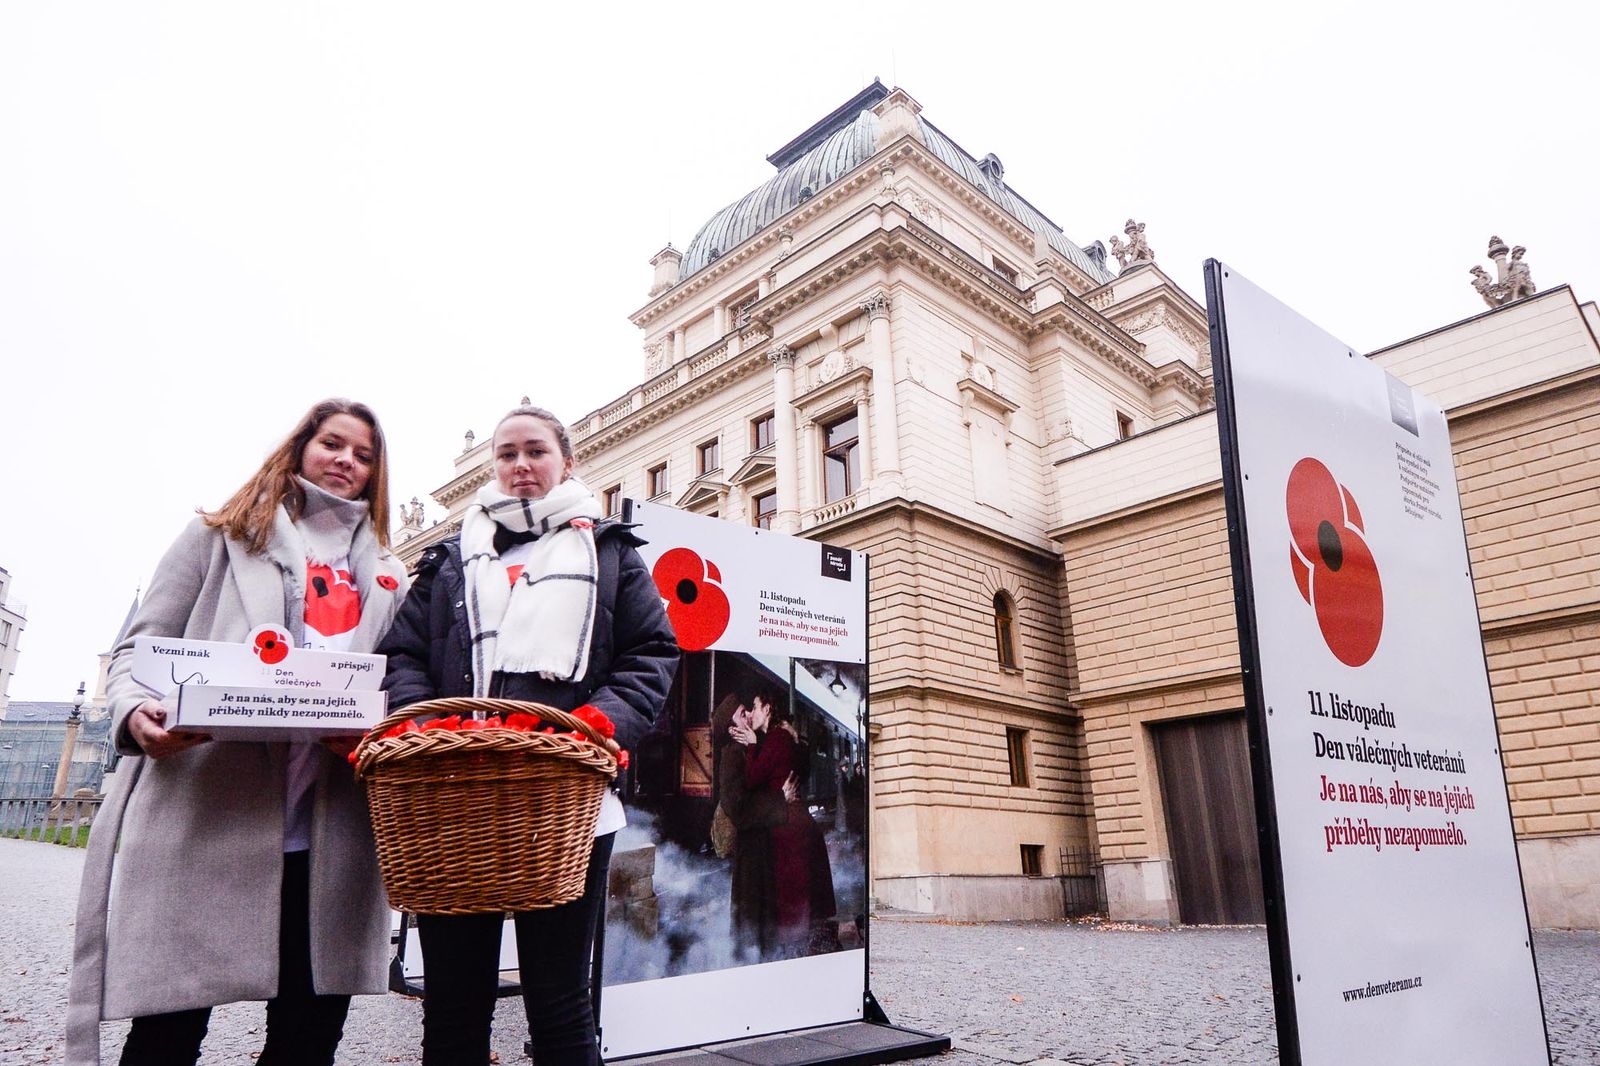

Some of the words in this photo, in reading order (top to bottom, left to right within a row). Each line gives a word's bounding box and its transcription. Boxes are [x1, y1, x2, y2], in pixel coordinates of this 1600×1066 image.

[760, 590, 769, 600] 11.
[771, 592, 806, 606] listopadu
[760, 602, 775, 613] Den
[776, 605, 813, 619] válečných
[814, 612, 846, 625] veteránů
[759, 615, 768, 624] Je
[769, 618, 779, 626] na
[780, 617, 796, 628] nás,
[796, 621, 809, 632] aby
[810, 624, 819, 632] se
[819, 626, 829, 634] na
[828, 626, 849, 637] jejich
[759, 627, 790, 641] příběhy
[790, 633, 840, 647] nezapomnělo.
[152, 645, 185, 656] Vezmi
[187, 649, 210, 658] mák
[275, 668, 294, 677] Den
[338, 660, 375, 672] přispěj!
[274, 678, 322, 688] válečných
[221, 693, 234, 703] Je
[236, 694, 250, 703] na
[253, 693, 275, 704] nás,
[277, 695, 296, 706] aby
[299, 697, 310, 705] se
[312, 697, 326, 706] na
[326, 697, 357, 707] jejich
[208, 704, 256, 717] příběhy
[257, 707, 289, 719] nikdy
[292, 709, 366, 720] nezapomnělo.
[1308, 690, 1329, 718] 11.
[1329, 692, 1396, 731] listopadu
[1313, 732, 1345, 760] Den
[1346, 735, 1413, 773] válečných
[1413, 749, 1467, 775] veteránů
[1320, 774, 1337, 802] Je
[1338, 783, 1358, 803] na
[1359, 777, 1388, 810] nás,
[1389, 780, 1411, 813] aby
[1414, 788, 1427, 807] se
[1428, 789, 1443, 808] na
[1443, 784, 1475, 815] jejich
[1324, 817, 1382, 853] příběhy
[1384, 821, 1468, 852] nezapomnělo.
[1342, 976, 1423, 1003] www.denveteranu.cz
